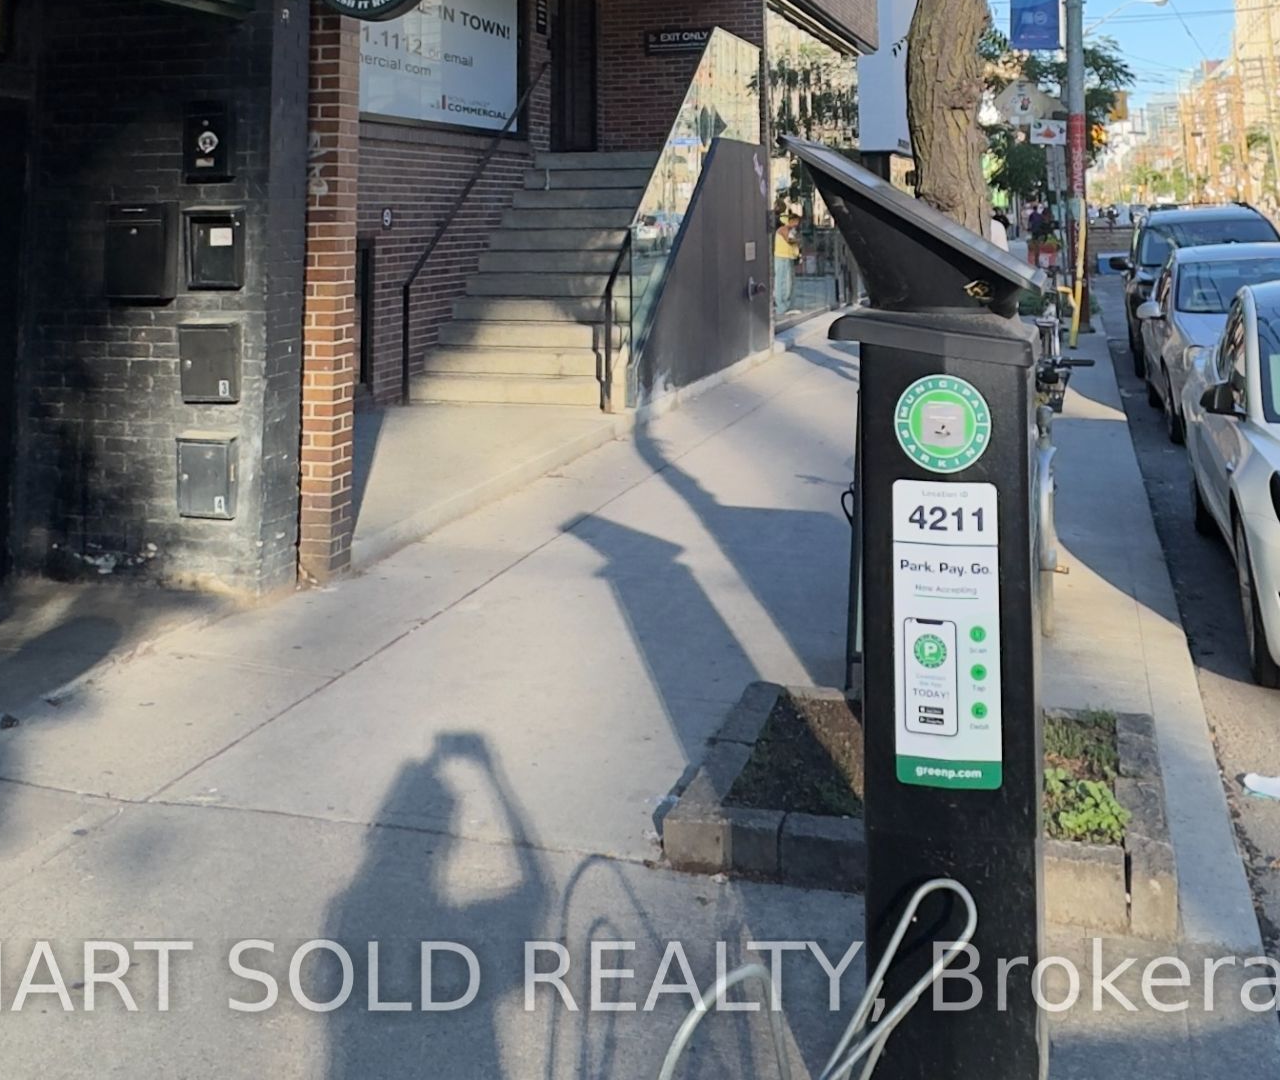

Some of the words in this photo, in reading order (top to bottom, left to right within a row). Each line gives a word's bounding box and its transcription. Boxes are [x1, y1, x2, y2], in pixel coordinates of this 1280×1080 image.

[358, 1, 369, 9] IT
[438, 5, 455, 23] IN
[460, 11, 511, 39] TOWN!
[660, 32, 681, 42] EXIT
[682, 31, 709, 41] ONLY
[443, 51, 474, 67] email
[447, 103, 508, 120] COMMERCIAL
[899, 379, 986, 421] MUNICIPAL
[901, 428, 985, 468] PARKING
[908, 505, 984, 532] 4211
[900, 559, 935, 573] Park.
[939, 563, 967, 577] Pay.
[915, 764, 983, 780] greenp.com
